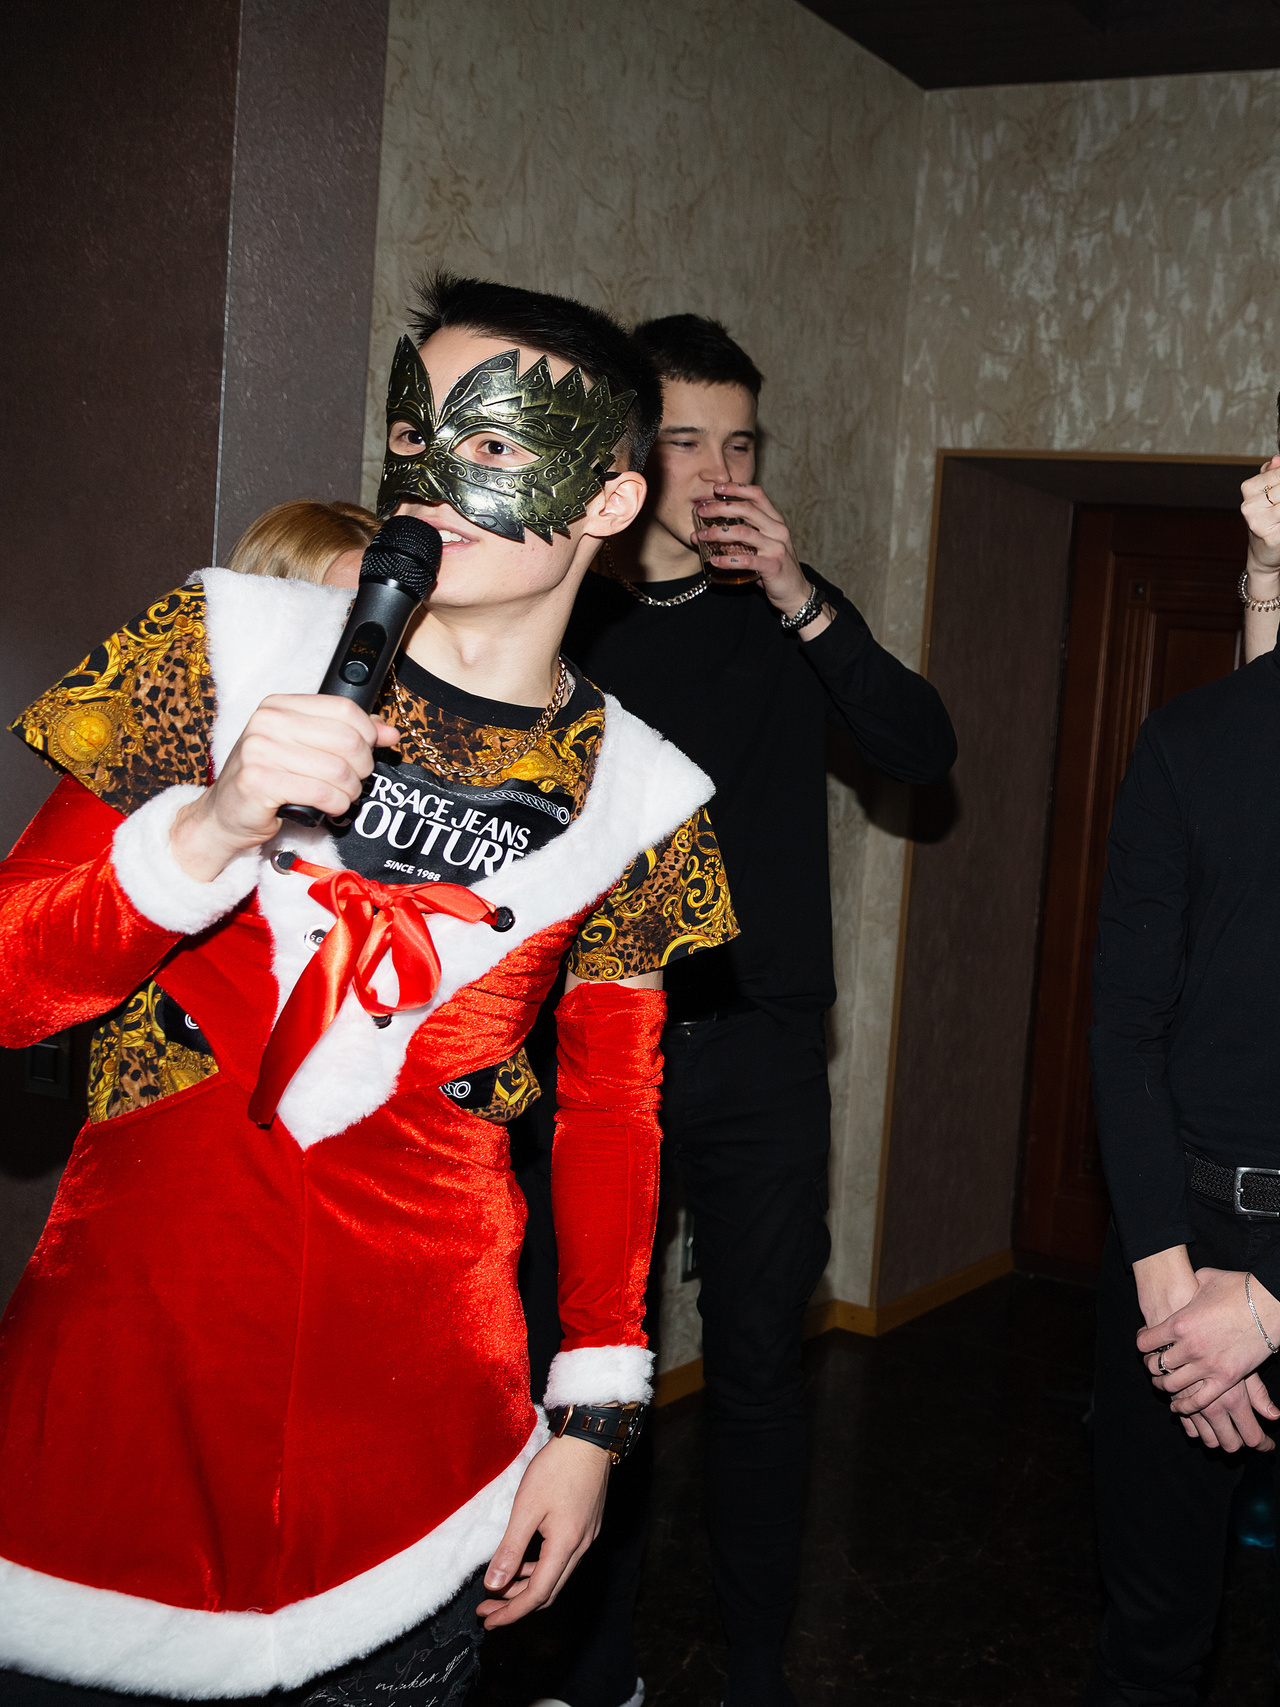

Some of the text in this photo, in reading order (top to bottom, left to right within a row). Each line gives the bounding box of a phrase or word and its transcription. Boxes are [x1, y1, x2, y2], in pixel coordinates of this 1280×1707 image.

[368, 772, 531, 851] RSACE JEANS
[383, 859, 441, 882] SINCE 1988
